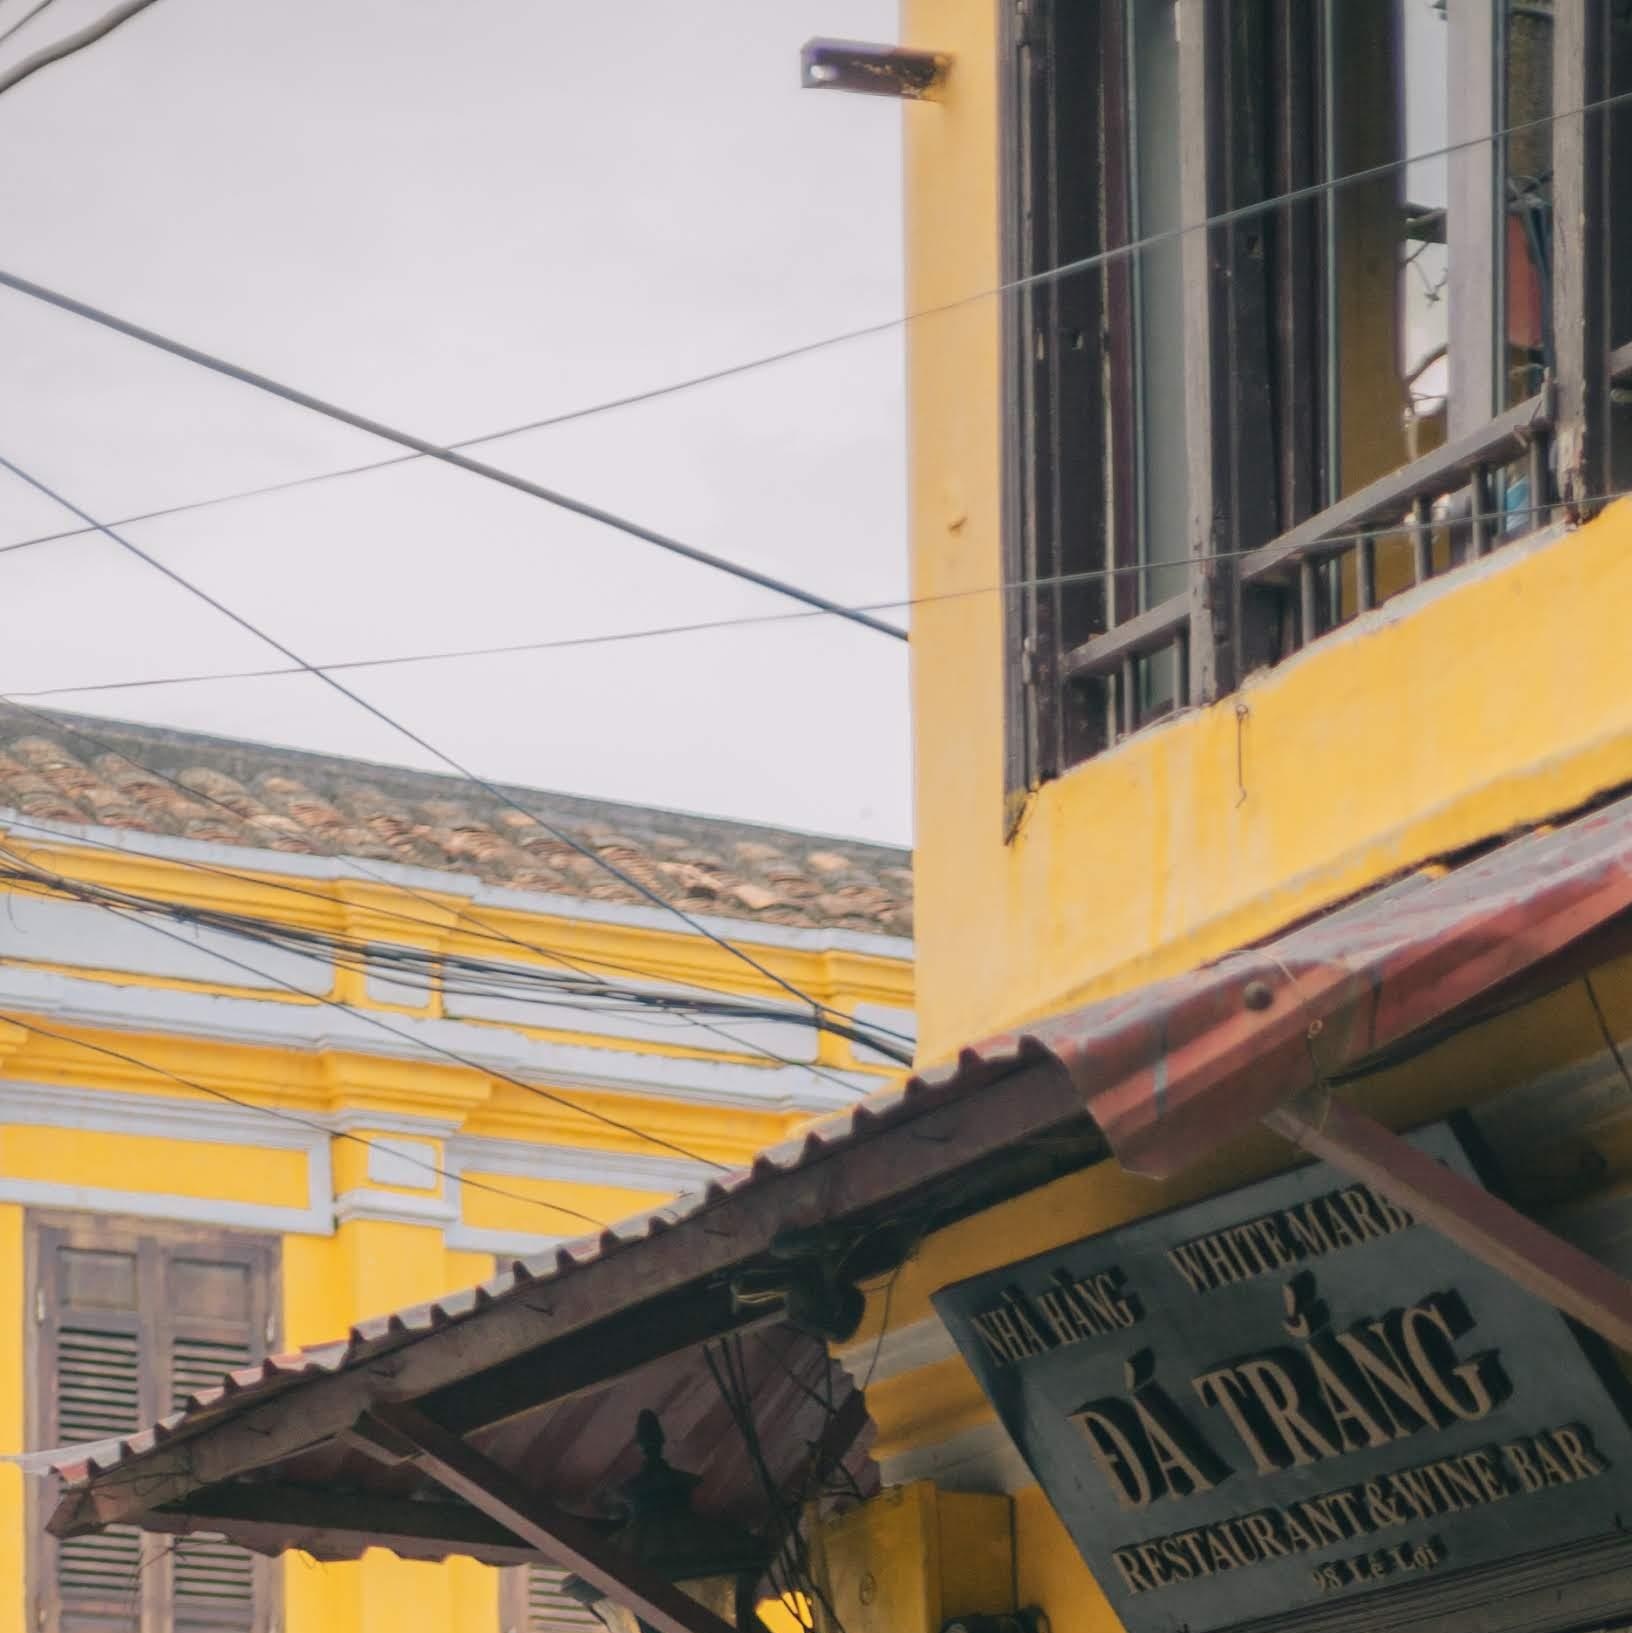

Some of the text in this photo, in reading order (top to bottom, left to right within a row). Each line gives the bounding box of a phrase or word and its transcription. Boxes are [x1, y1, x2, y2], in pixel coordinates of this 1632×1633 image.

[1167, 1215, 1298, 1294] WHITE
[1112, 1493, 1366, 1597] RESTAURANT
[1502, 1429, 1600, 1495] BAR
